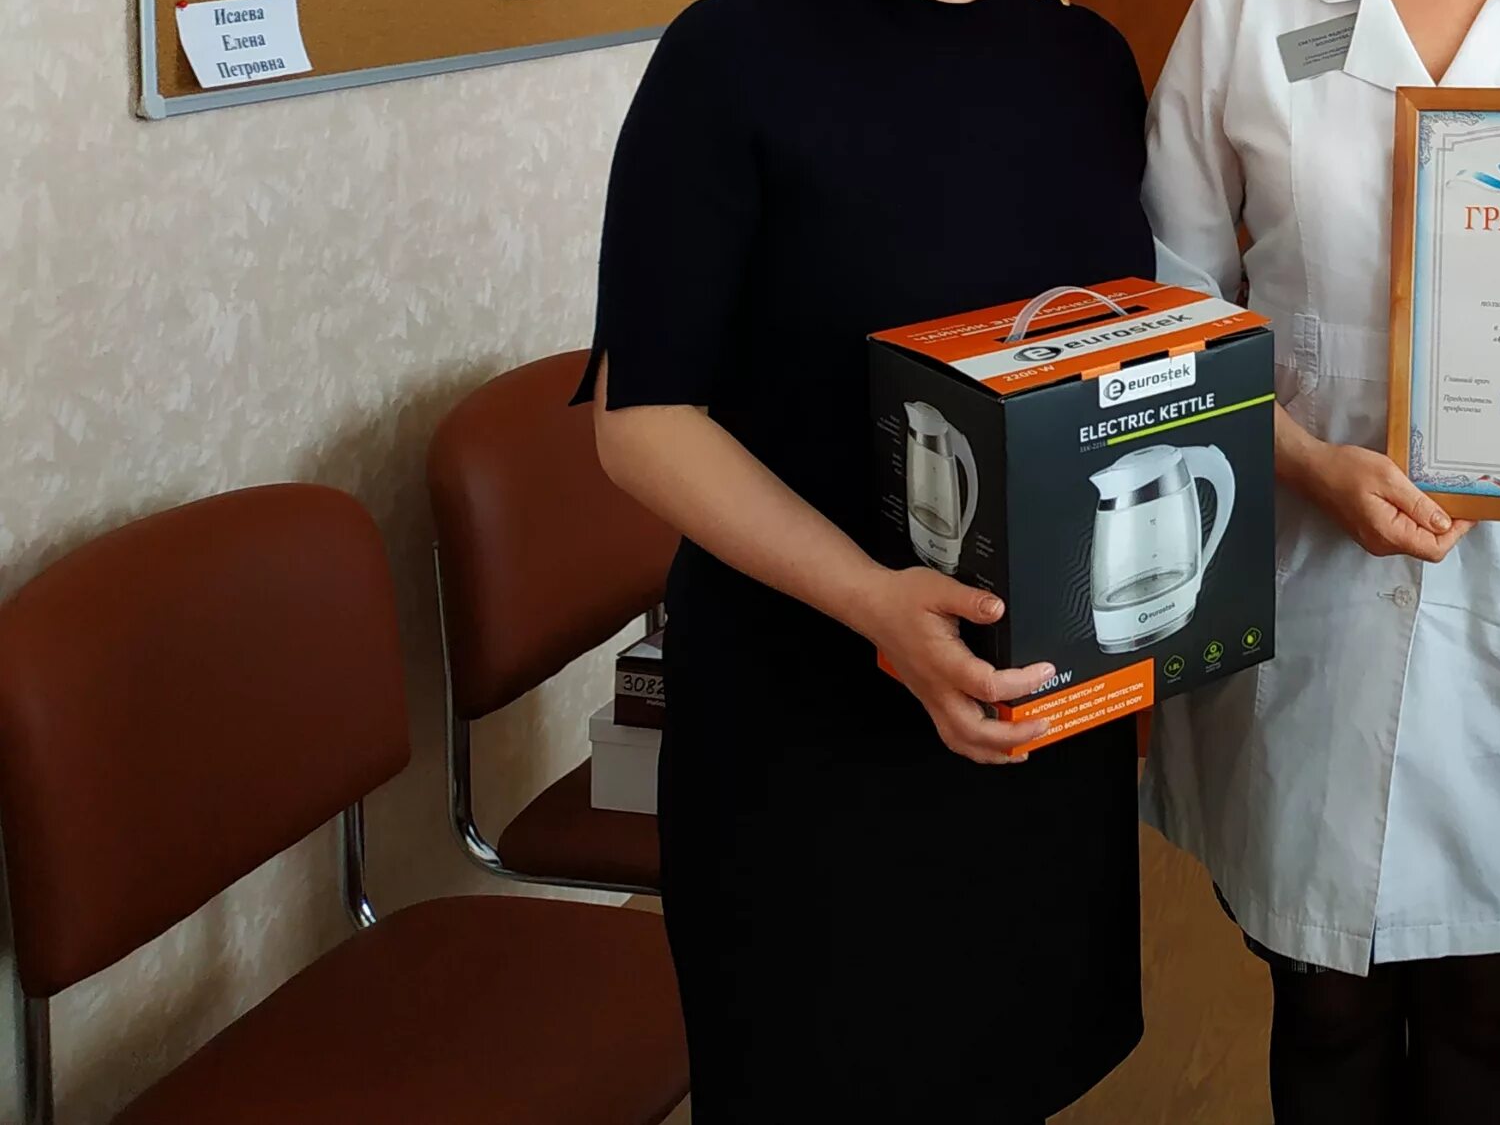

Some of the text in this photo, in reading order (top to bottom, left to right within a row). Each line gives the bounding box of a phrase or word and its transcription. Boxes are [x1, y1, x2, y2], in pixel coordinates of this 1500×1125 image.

[214, 5, 265, 26] Исаева
[222, 32, 266, 52] Елена
[216, 56, 286, 80] Петровна
[1064, 311, 1193, 349] eurostek
[1003, 364, 1056, 382] 2200 W
[1128, 363, 1191, 391] eurostek
[1080, 393, 1215, 443] ELECTRIC KETTLE
[1031, 696, 1068, 715] AUTOMATIC
[1064, 705, 1079, 716] AND
[1107, 682, 1144, 700] PROTECTION
[1106, 701, 1126, 714] GLASS
